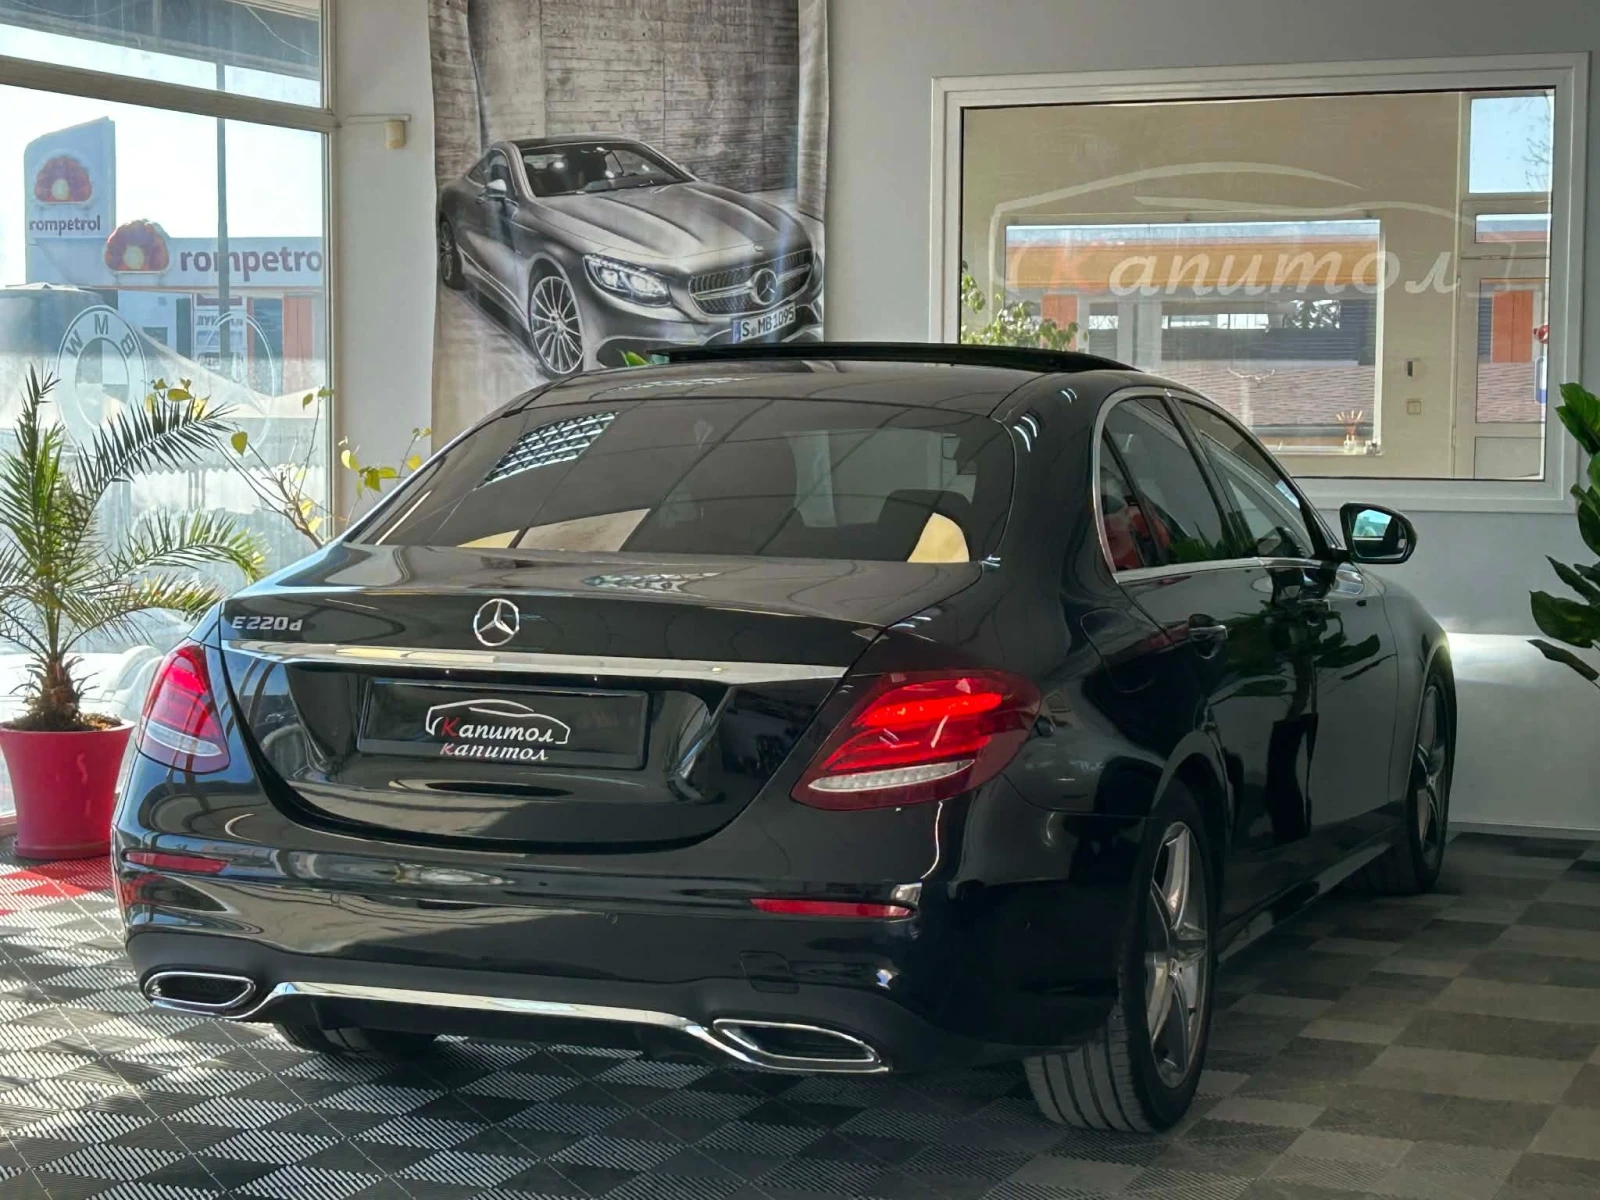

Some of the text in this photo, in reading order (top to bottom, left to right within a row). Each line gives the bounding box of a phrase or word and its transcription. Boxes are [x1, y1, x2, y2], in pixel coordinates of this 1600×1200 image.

[29, 214, 101, 237] rompetrol
[742, 321, 750, 337] S
[440, 716, 554, 743] Капитол
